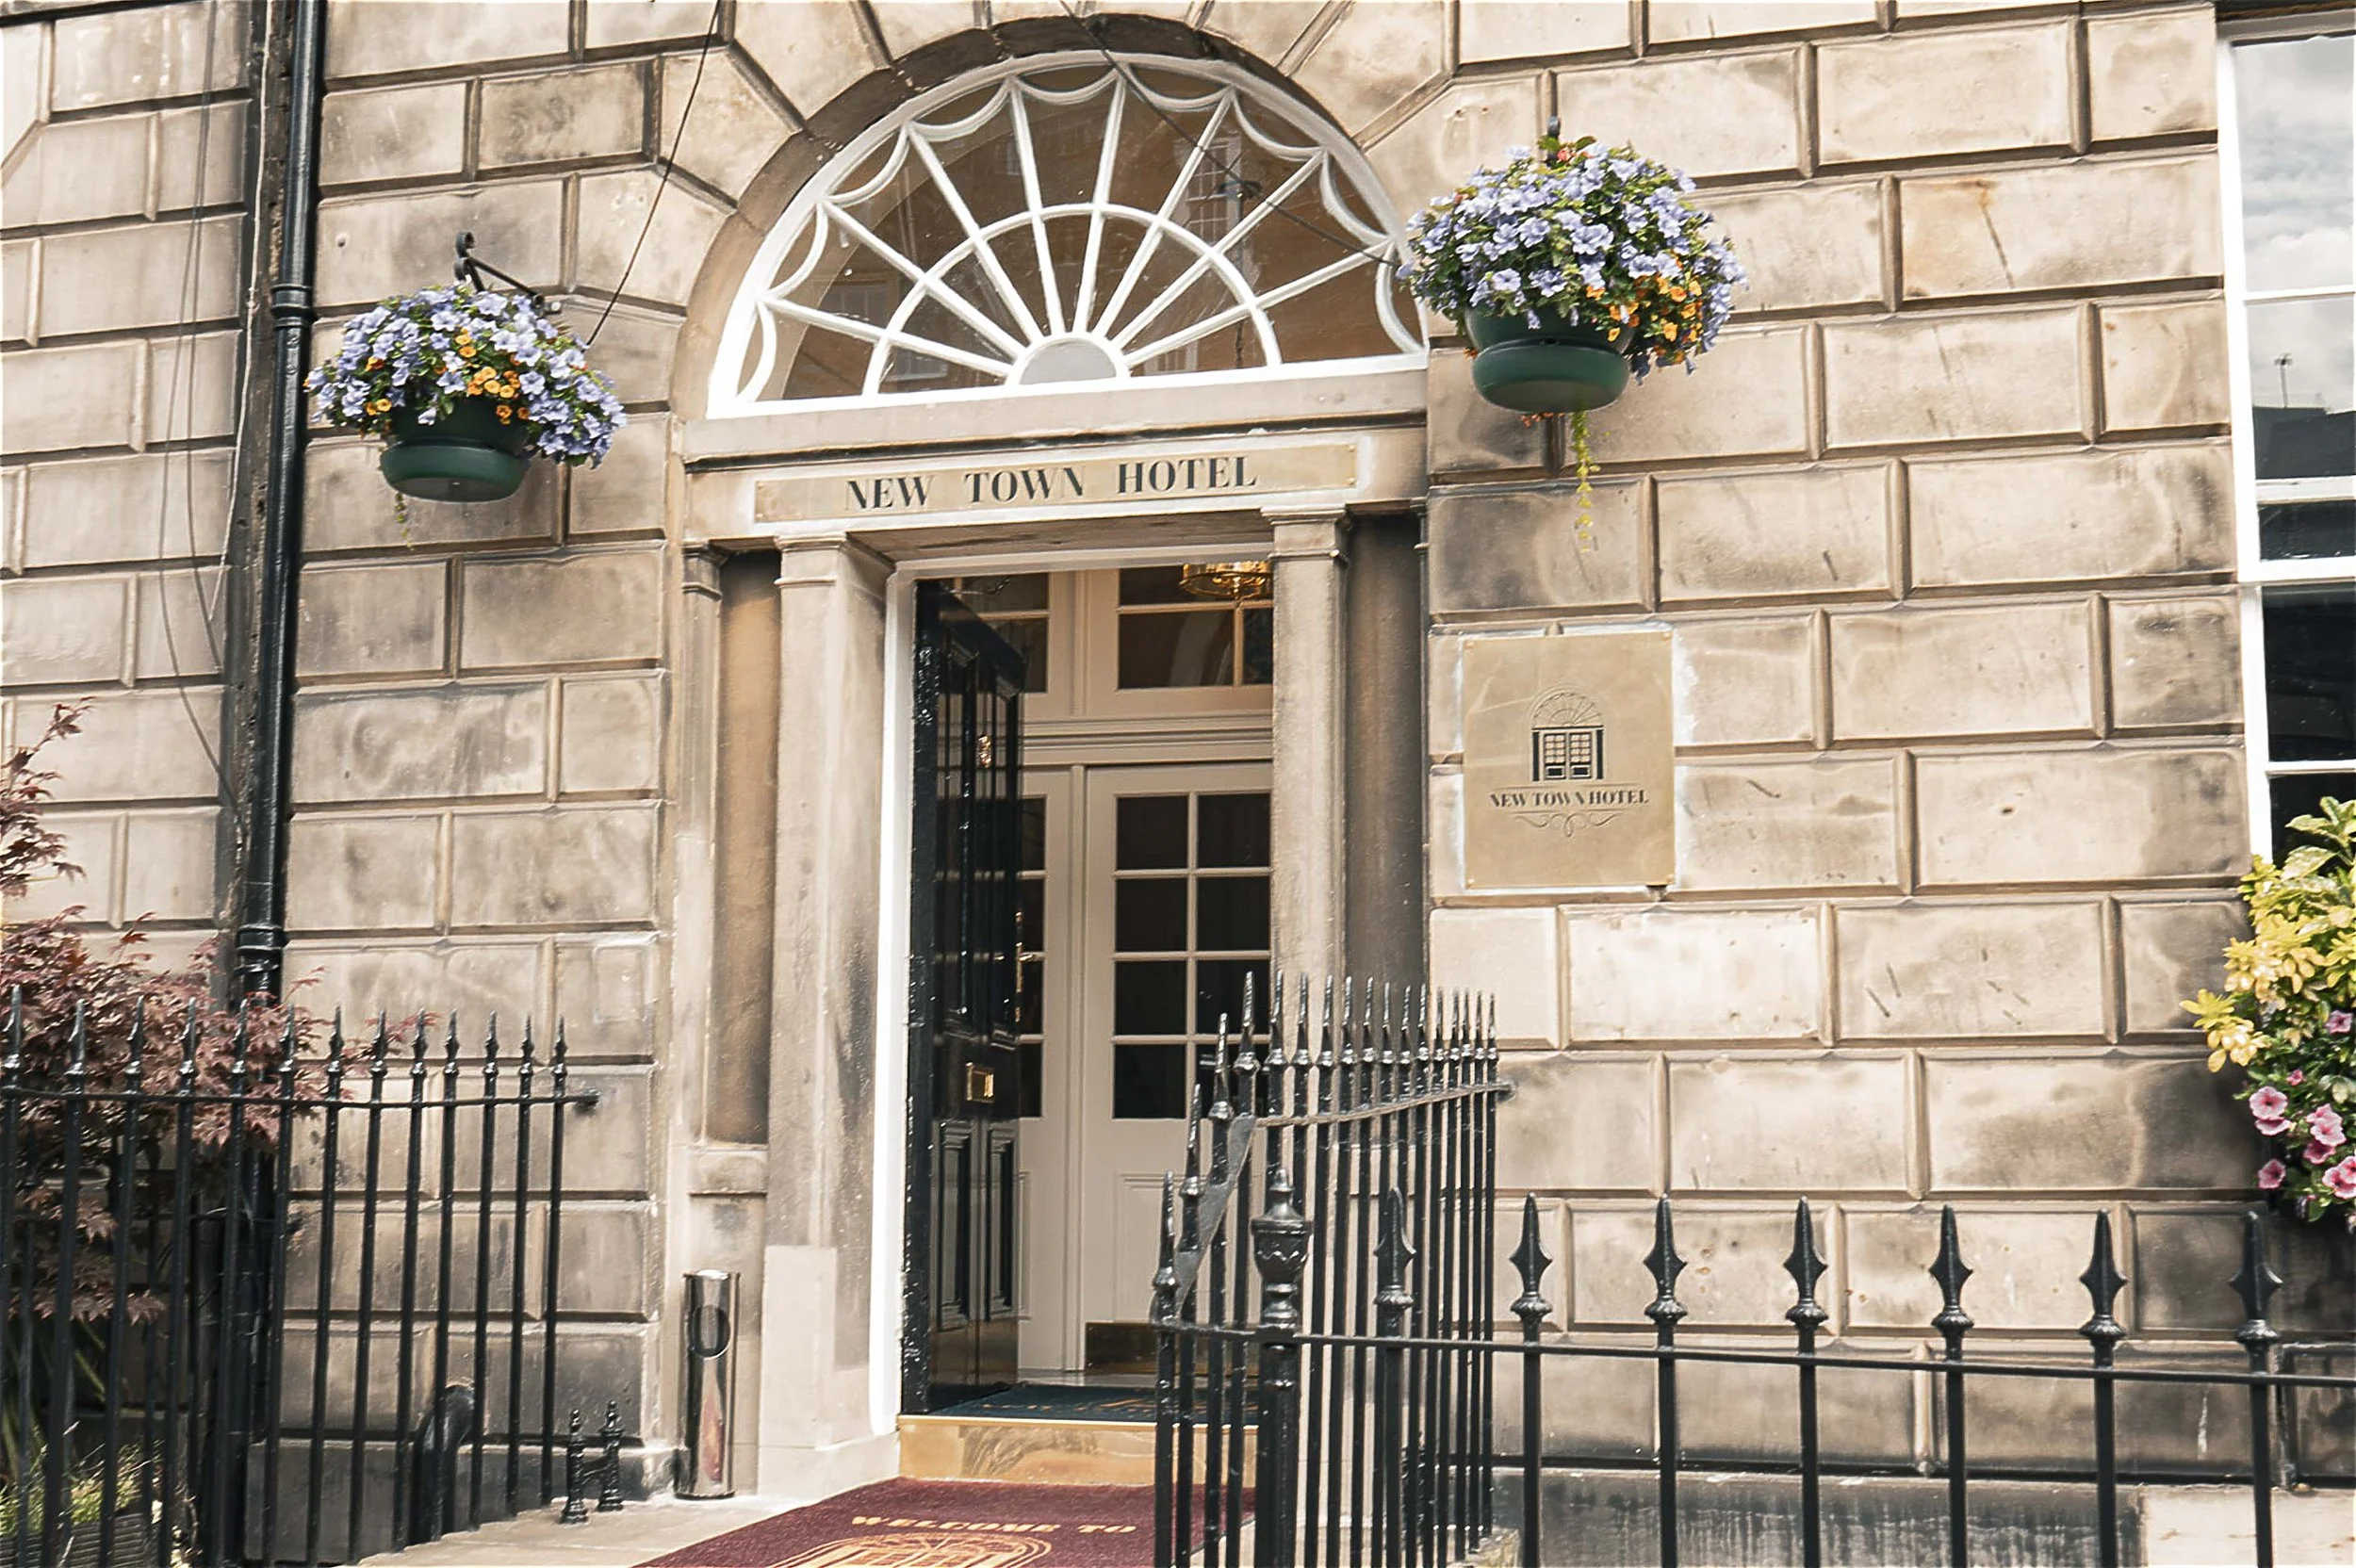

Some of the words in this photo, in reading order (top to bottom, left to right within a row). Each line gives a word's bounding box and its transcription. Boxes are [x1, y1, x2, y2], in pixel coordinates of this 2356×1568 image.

[846, 474, 935, 511] NEW
[964, 466, 1085, 505] TOWN
[1116, 455, 1260, 495] HOTEL
[1490, 792, 1526, 808] NEW
[1532, 791, 1585, 806] TOWN
[1589, 789, 1649, 805] HOTEL
[851, 1515, 1061, 1533] WELCOME
[1077, 1523, 1137, 1534] TO
